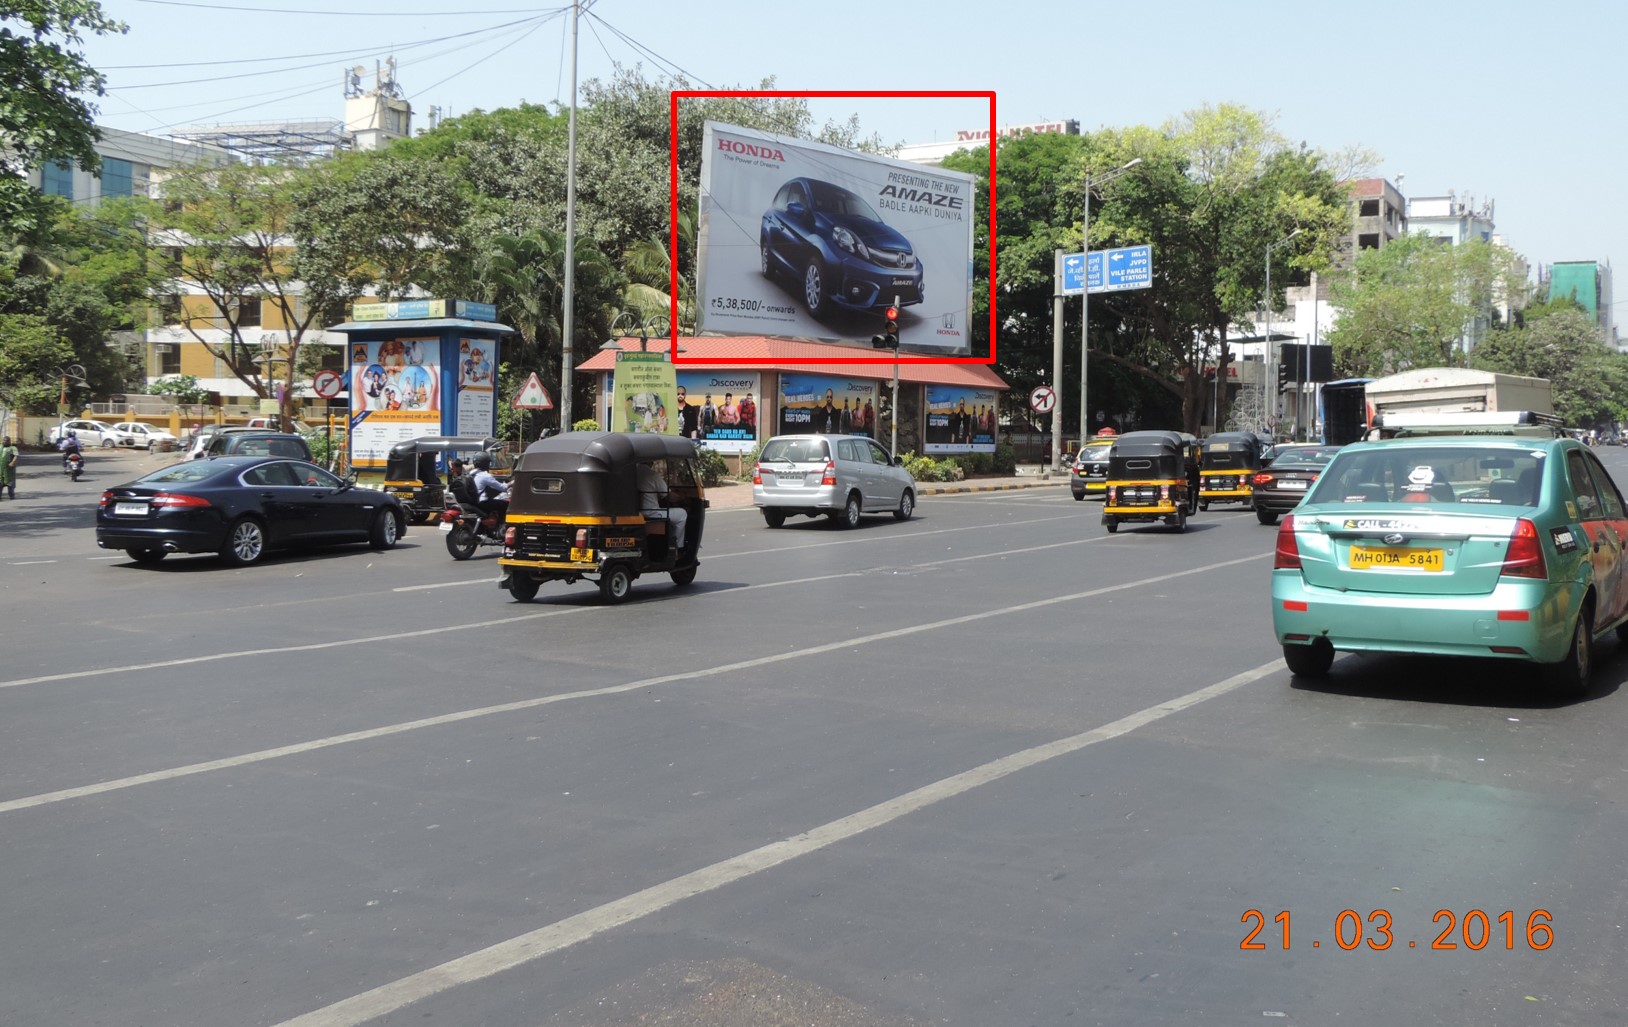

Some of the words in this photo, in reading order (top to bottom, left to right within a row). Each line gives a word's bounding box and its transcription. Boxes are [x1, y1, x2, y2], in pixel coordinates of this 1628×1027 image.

[718, 138, 785, 162] HONDA
[724, 154, 735, 162] The
[736, 156, 752, 165] Power
[760, 161, 780, 169] Dreams
[888, 171, 930, 189] PRESENTING
[931, 180, 944, 192] THE
[944, 183, 960, 194] NEW
[879, 185, 964, 210] AMAZE
[880, 198, 906, 213] BADLE
[908, 204, 932, 217] AAPKI
[934, 208, 963, 222] DUNIYA
[1131, 250, 1147, 258] IRLA
[1126, 267, 1147, 275] PARLE
[1121, 273, 1147, 282] STATION
[766, 305, 796, 314] onwards
[709, 379, 754, 389] Discovery
[848, 382, 873, 394] Discovery
[795, 414, 811, 422] 10PM
[1357, 520, 1379, 529] CALL
[1354, 553, 1373, 562] MH
[1409, 555, 1439, 565] 5841
